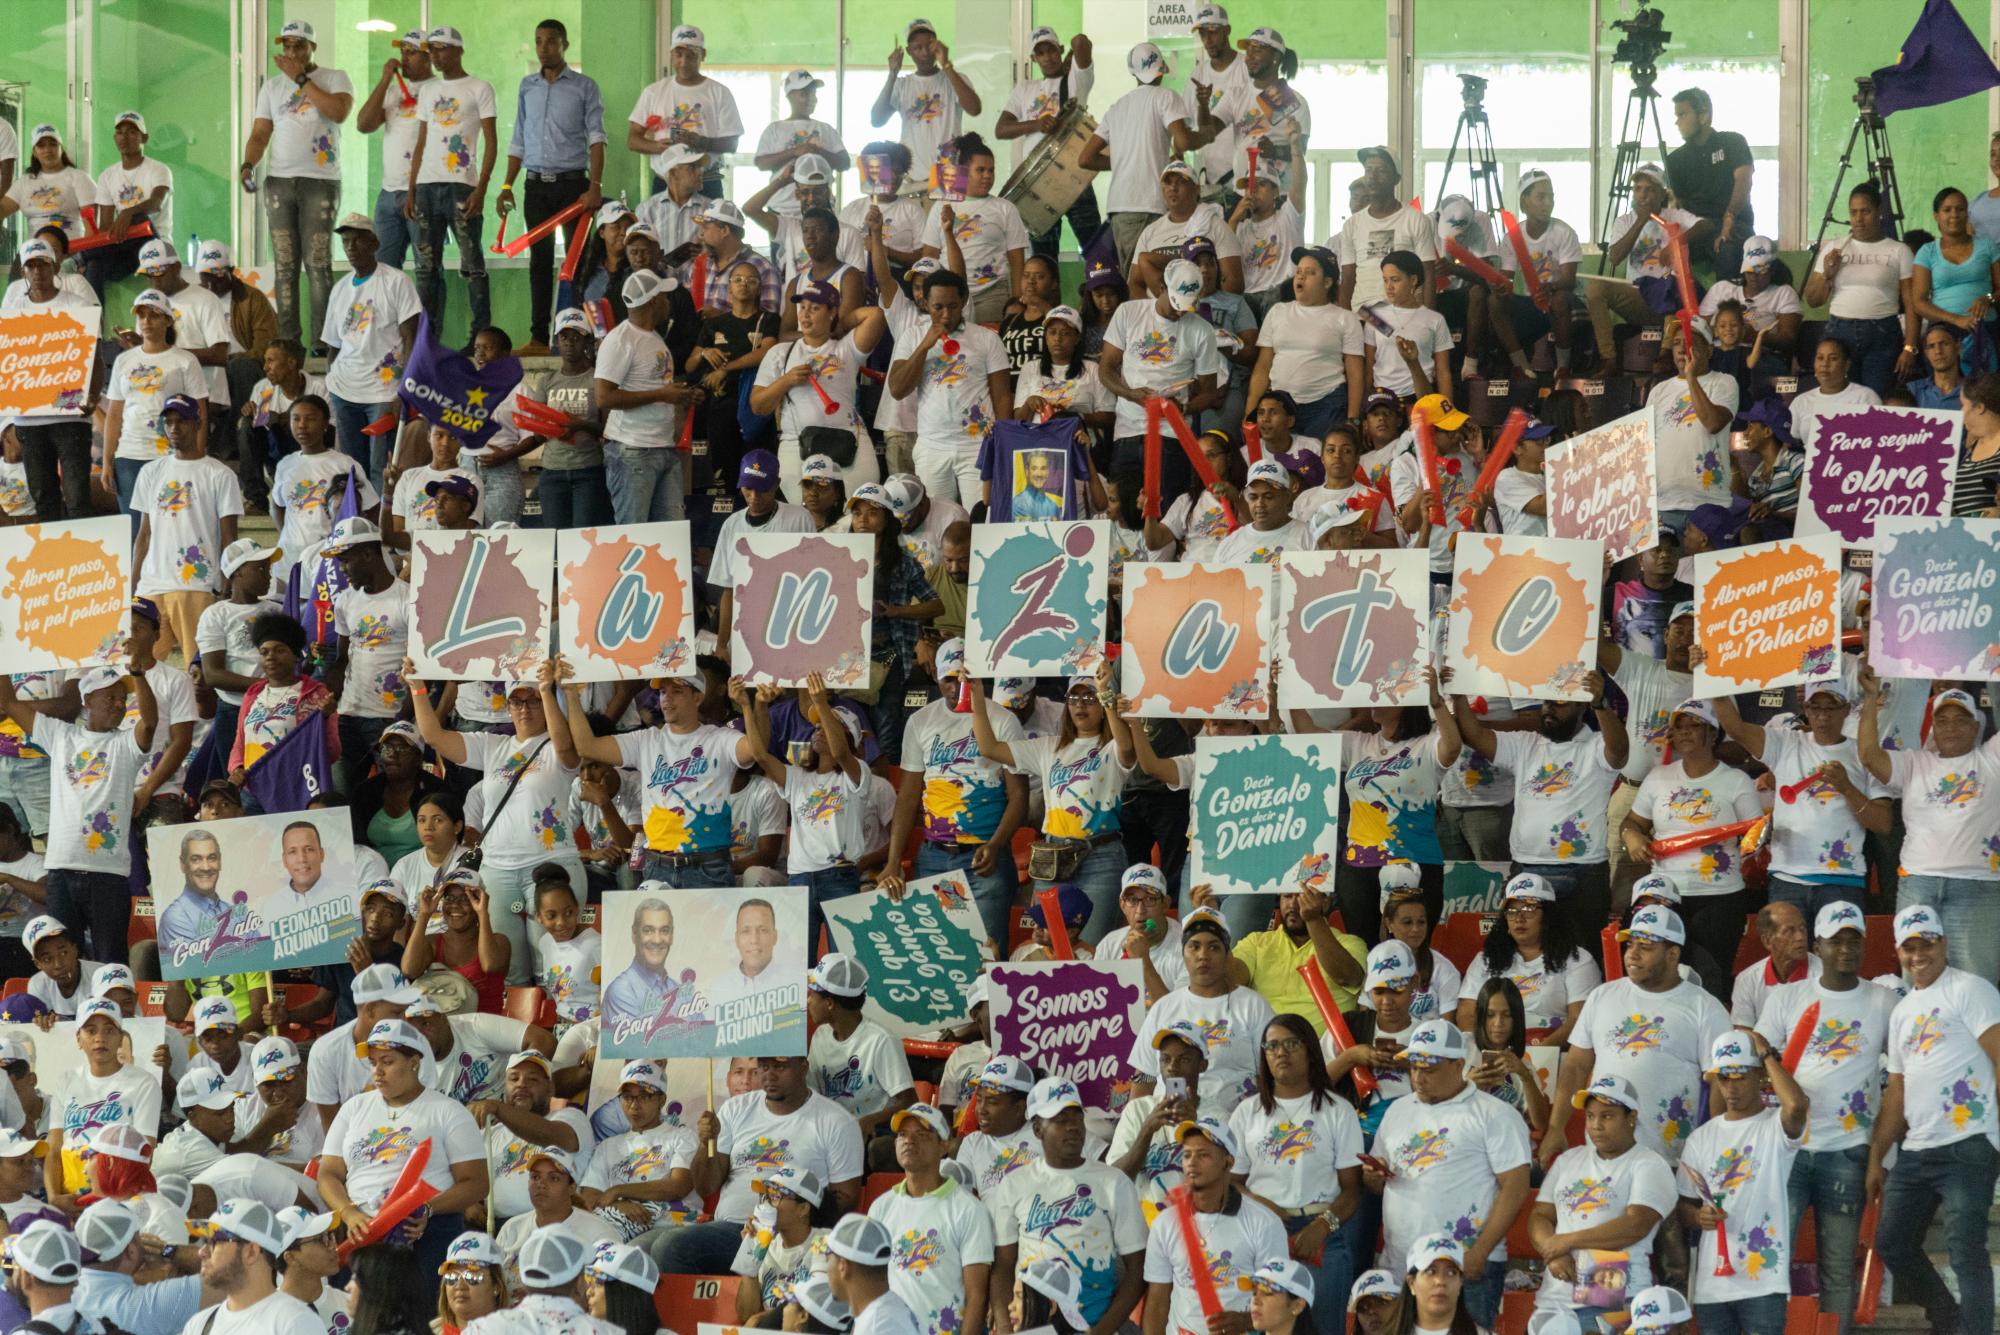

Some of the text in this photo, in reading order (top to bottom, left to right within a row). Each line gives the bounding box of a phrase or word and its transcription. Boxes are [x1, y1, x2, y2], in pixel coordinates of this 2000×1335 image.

[1149, 15, 1194, 26] CAMARA
[1158, 4, 1186, 14] AREA
[0, 342, 81, 374] Gonzalo
[12, 366, 82, 392] Palacio
[548, 388, 589, 401] LOVE
[404, 377, 489, 421] GONZALO
[1829, 428, 1934, 453] Para seguir
[1562, 463, 1593, 490] Para
[1821, 453, 1928, 494] la obra
[1561, 471, 1637, 524] la obra
[1826, 492, 1930, 524] en el 2020
[1595, 494, 1641, 541] 2020
[19, 559, 106, 591] Abran paso,
[1889, 559, 1997, 599] Gonzalo
[1925, 558, 1958, 575] Decir
[24, 571, 117, 616] que Gonzalo
[1711, 564, 1819, 610] Abran paso,
[1934, 596, 1960, 608] decir
[24, 596, 121, 634] va pal palacio
[427, 536, 527, 660] L
[596, 545, 664, 650] á
[766, 567, 839, 649] n
[986, 548, 1079, 672] Z
[1163, 598, 1240, 679] a
[1491, 575, 1561, 656] e
[1706, 583, 1824, 637] que Gonzalo
[1897, 592, 1993, 643] Danilo
[1718, 639, 1734, 653] va
[1720, 616, 1829, 667] pal Palacio
[1208, 773, 1312, 818] Gonzalo
[1243, 775, 1275, 792] Decir
[1216, 806, 1308, 860] Danilo
[1251, 810, 1277, 824] decir
[268, 895, 352, 941] LEONARDO
[912, 903, 967, 961] pelea
[273, 924, 330, 960] AQUINO
[886, 910, 945, 978] ganao
[868, 931, 920, 1002] El que
[715, 984, 800, 1026] LEONARDO
[1017, 985, 1109, 1024] Somos
[715, 1012, 774, 1048] AQUINO
[1019, 1014, 1124, 1061] Sangre
[1038, 1052, 1119, 1084] Nueva
[697, 1281, 718, 1298] 10
